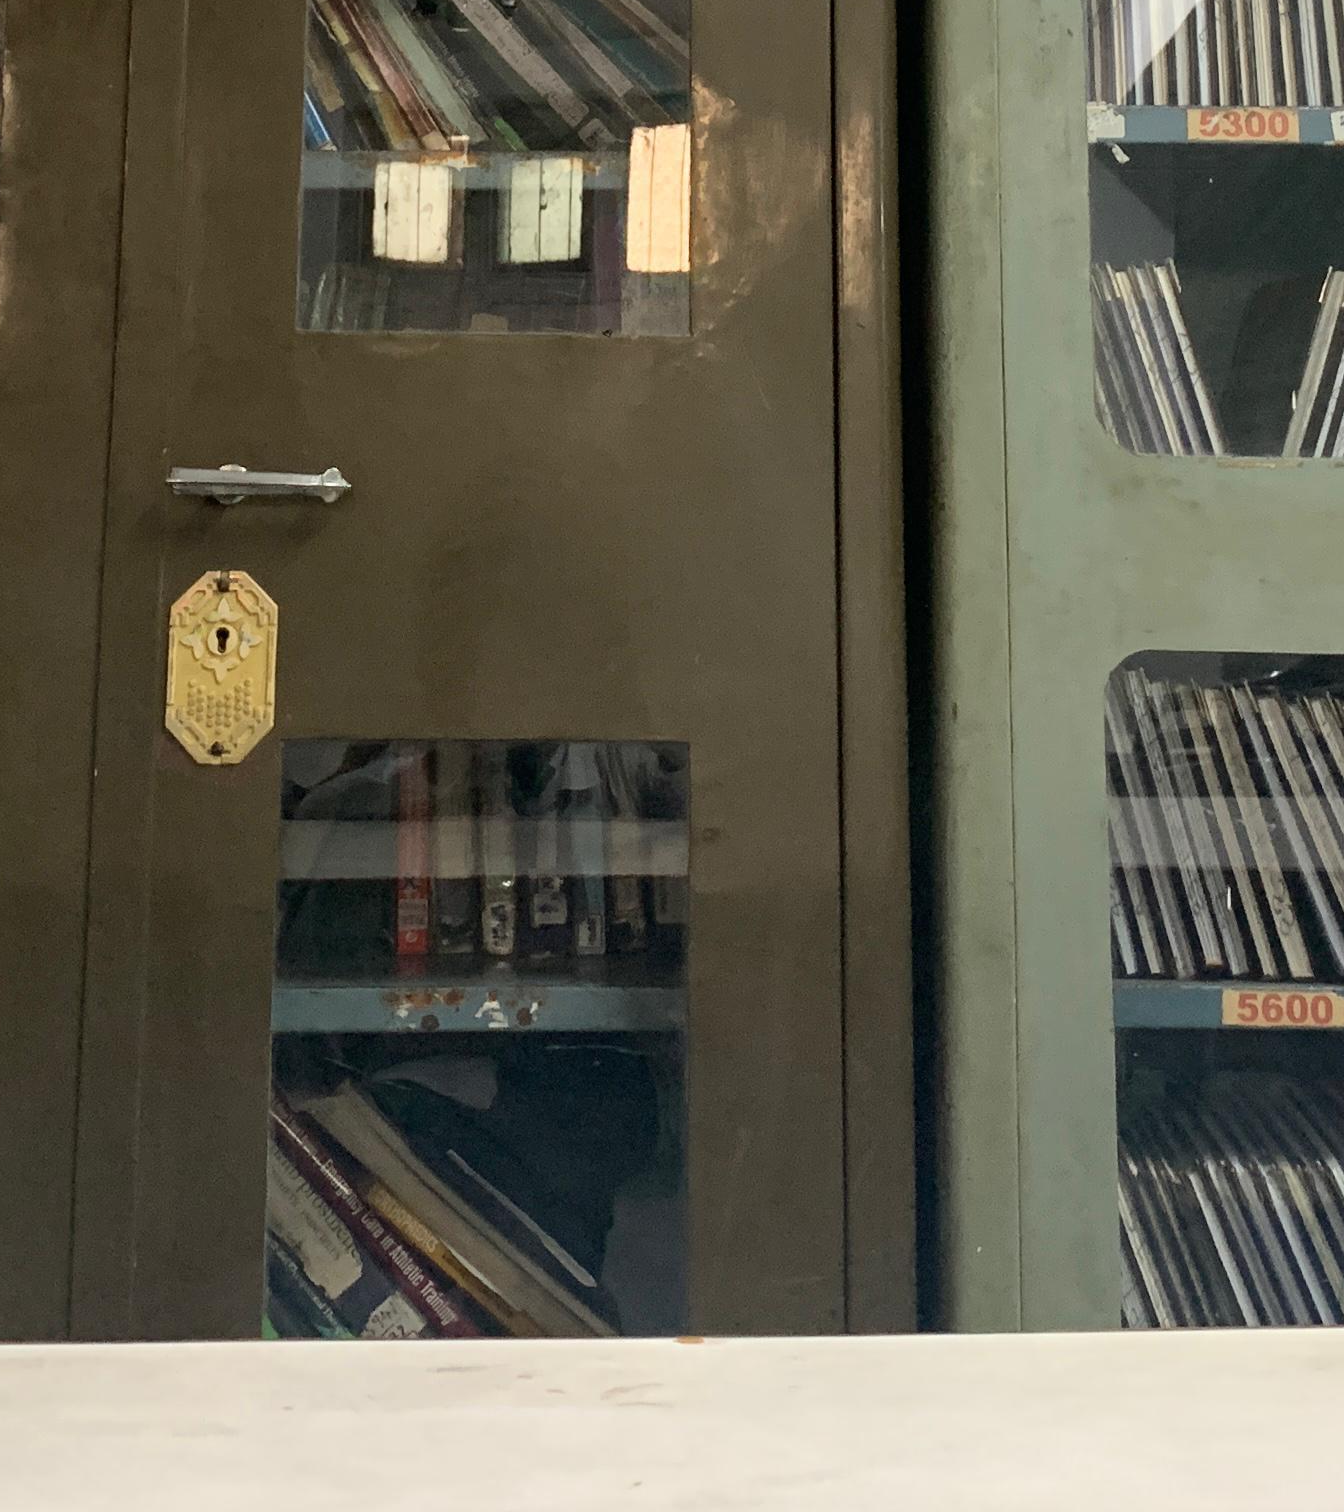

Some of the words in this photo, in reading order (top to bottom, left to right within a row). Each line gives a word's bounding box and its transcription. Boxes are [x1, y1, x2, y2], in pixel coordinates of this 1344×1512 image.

[1199, 110, 1289, 138] 5300
[1236, 993, 1336, 1025] 5600
[322, 1158, 362, 1216] Emergency
[360, 1211, 386, 1239] Care
[378, 1233, 396, 1252] in
[388, 1244, 426, 1286] Athletic
[416, 1279, 459, 1328] Training
